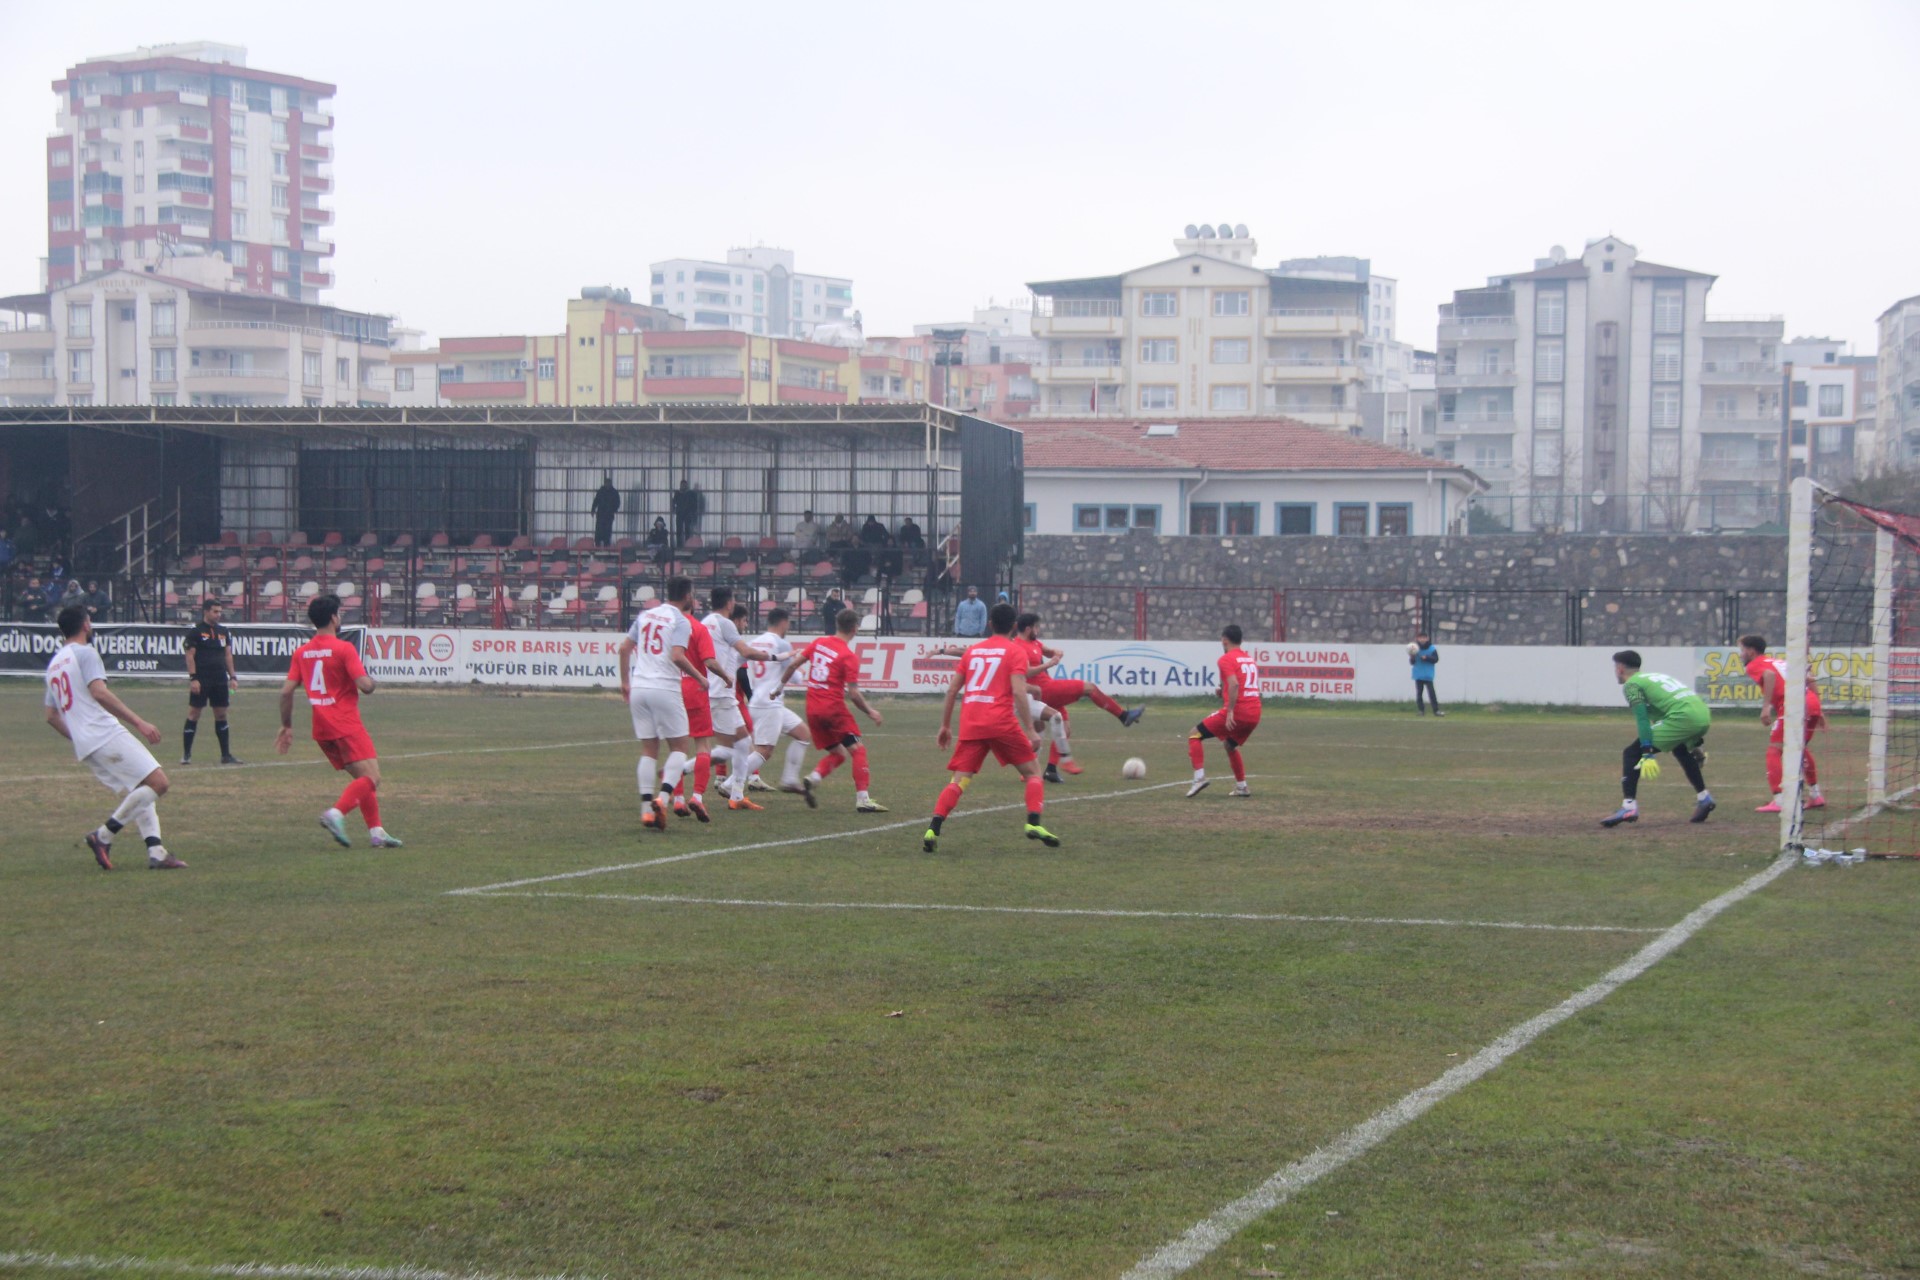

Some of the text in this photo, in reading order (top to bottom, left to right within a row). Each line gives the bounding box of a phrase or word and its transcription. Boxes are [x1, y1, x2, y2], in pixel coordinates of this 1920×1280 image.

[0, 629, 31, 653] GÜN
[33, 634, 66, 653] DOS
[92, 631, 145, 654] İVEREK
[472, 640, 516, 653] SPOR
[522, 641, 572, 656] BARIŞ
[578, 642, 599, 654] VE
[641, 622, 664, 655] 15
[117, 660, 159, 671] 6 ŞUBAT
[1246, 648, 1350, 664] İG YOLUNDA
[310, 659, 328, 695] 4
[532, 662, 558, 676] BİR
[563, 664, 616, 677] AHLAK
[967, 657, 1002, 692] 27
[1054, 663, 1215, 687] Adil Katı Atık
[1241, 663, 1258, 689] 22
[51, 671, 74, 713] 29
[1259, 680, 1353, 694] RILAR DİLER
[1816, 685, 1872, 701] TLERİ
